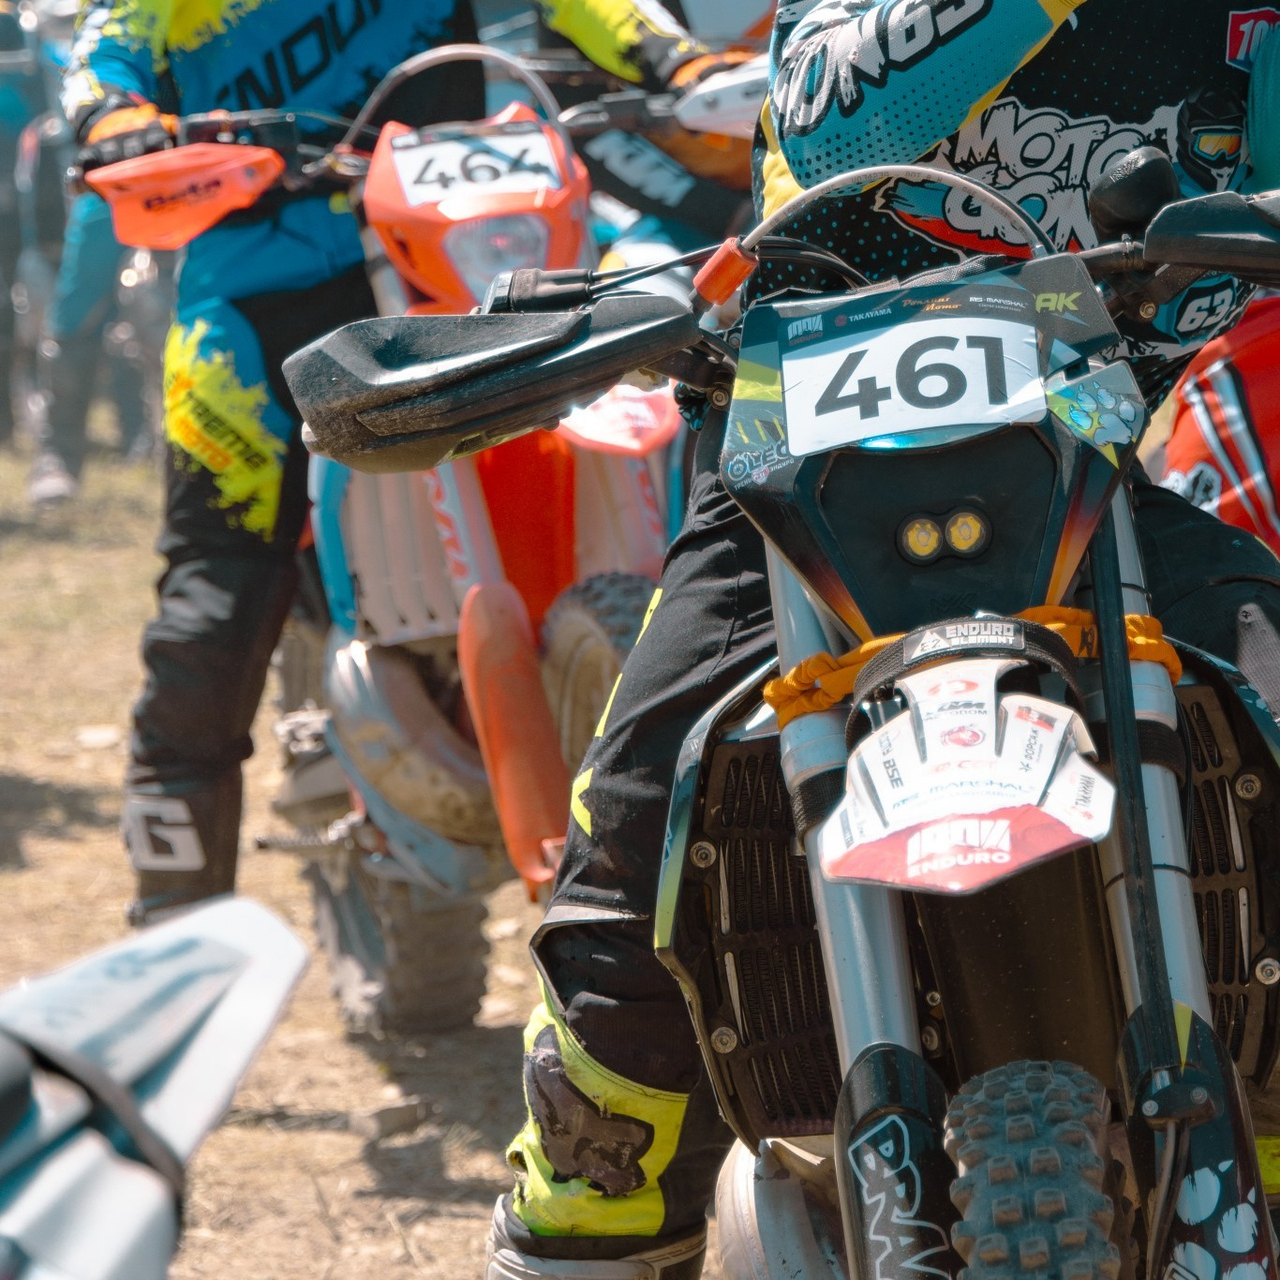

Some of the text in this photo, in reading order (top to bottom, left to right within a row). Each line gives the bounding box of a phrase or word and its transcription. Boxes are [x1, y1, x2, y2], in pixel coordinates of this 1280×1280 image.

[412, 147, 549, 191] 464
[848, 307, 892, 322] TAKAYAMA
[1035, 291, 1083, 314] AK
[1176, 287, 1234, 333] 63
[813, 334, 1009, 421] 461
[945, 622, 1015, 639] ENDURO
[950, 635, 1015, 647] ELEMENT
[882, 757, 904, 790] BSE
[906, 851, 1012, 878] ENDURO
